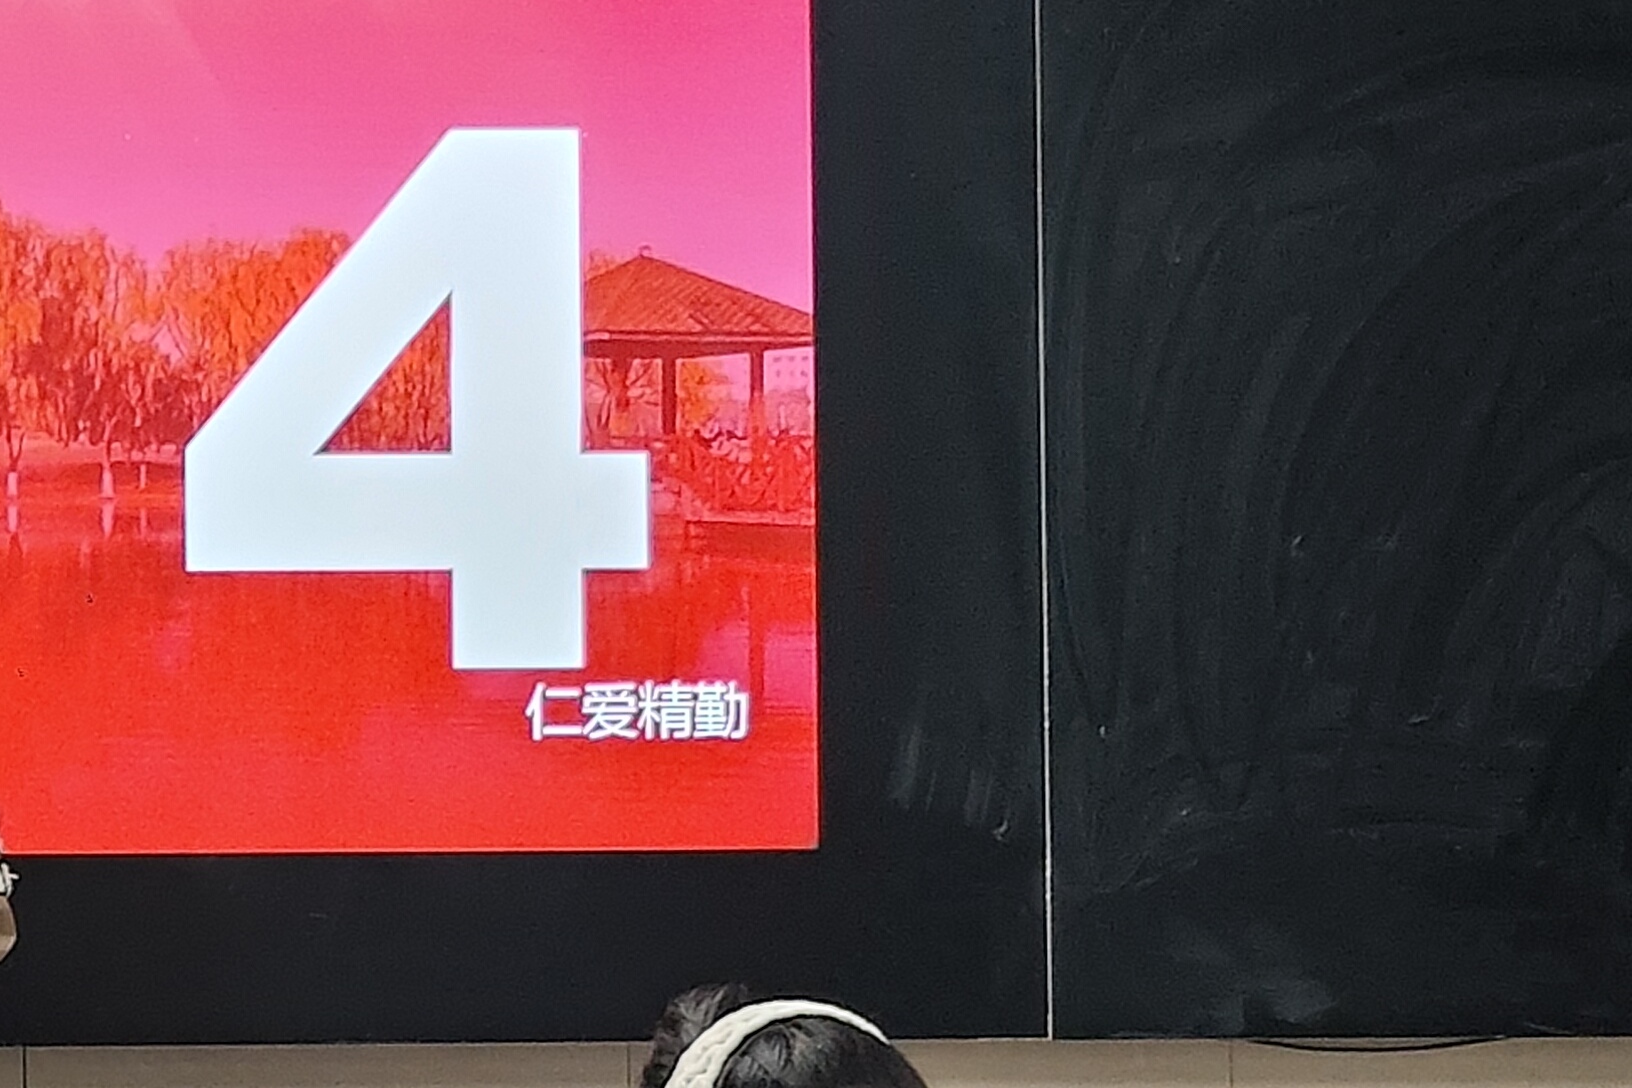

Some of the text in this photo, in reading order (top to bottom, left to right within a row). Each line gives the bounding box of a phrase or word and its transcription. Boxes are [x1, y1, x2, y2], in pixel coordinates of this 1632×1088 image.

[184, 127, 651, 669] 4
[524, 679, 750, 742] 仁爱精勤
